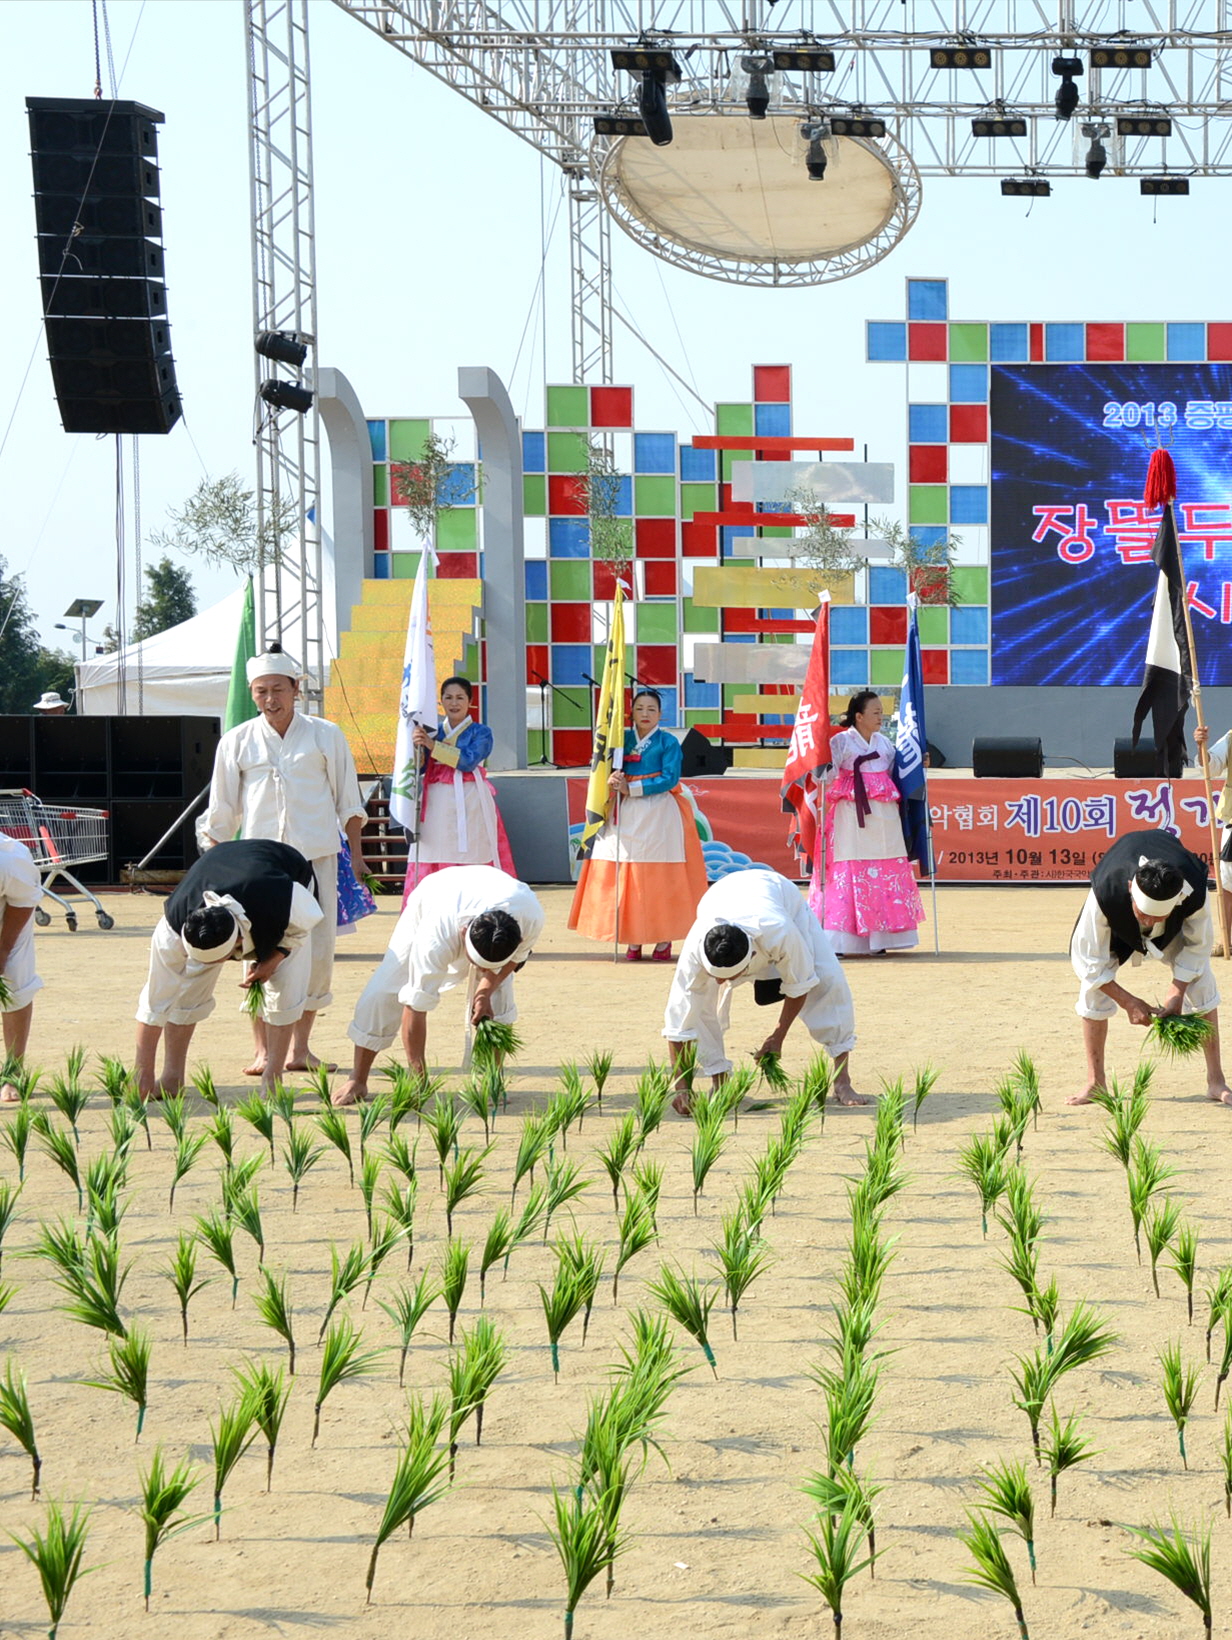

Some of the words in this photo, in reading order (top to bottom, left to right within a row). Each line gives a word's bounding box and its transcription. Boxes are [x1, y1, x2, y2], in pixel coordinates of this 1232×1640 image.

[1103, 402, 1178, 427] 2013
[1005, 795, 1117, 837] 제10회
[949, 851, 998, 865] 2013년
[1005, 849, 1042, 866] 10월
[1050, 849, 1085, 866] 13일
